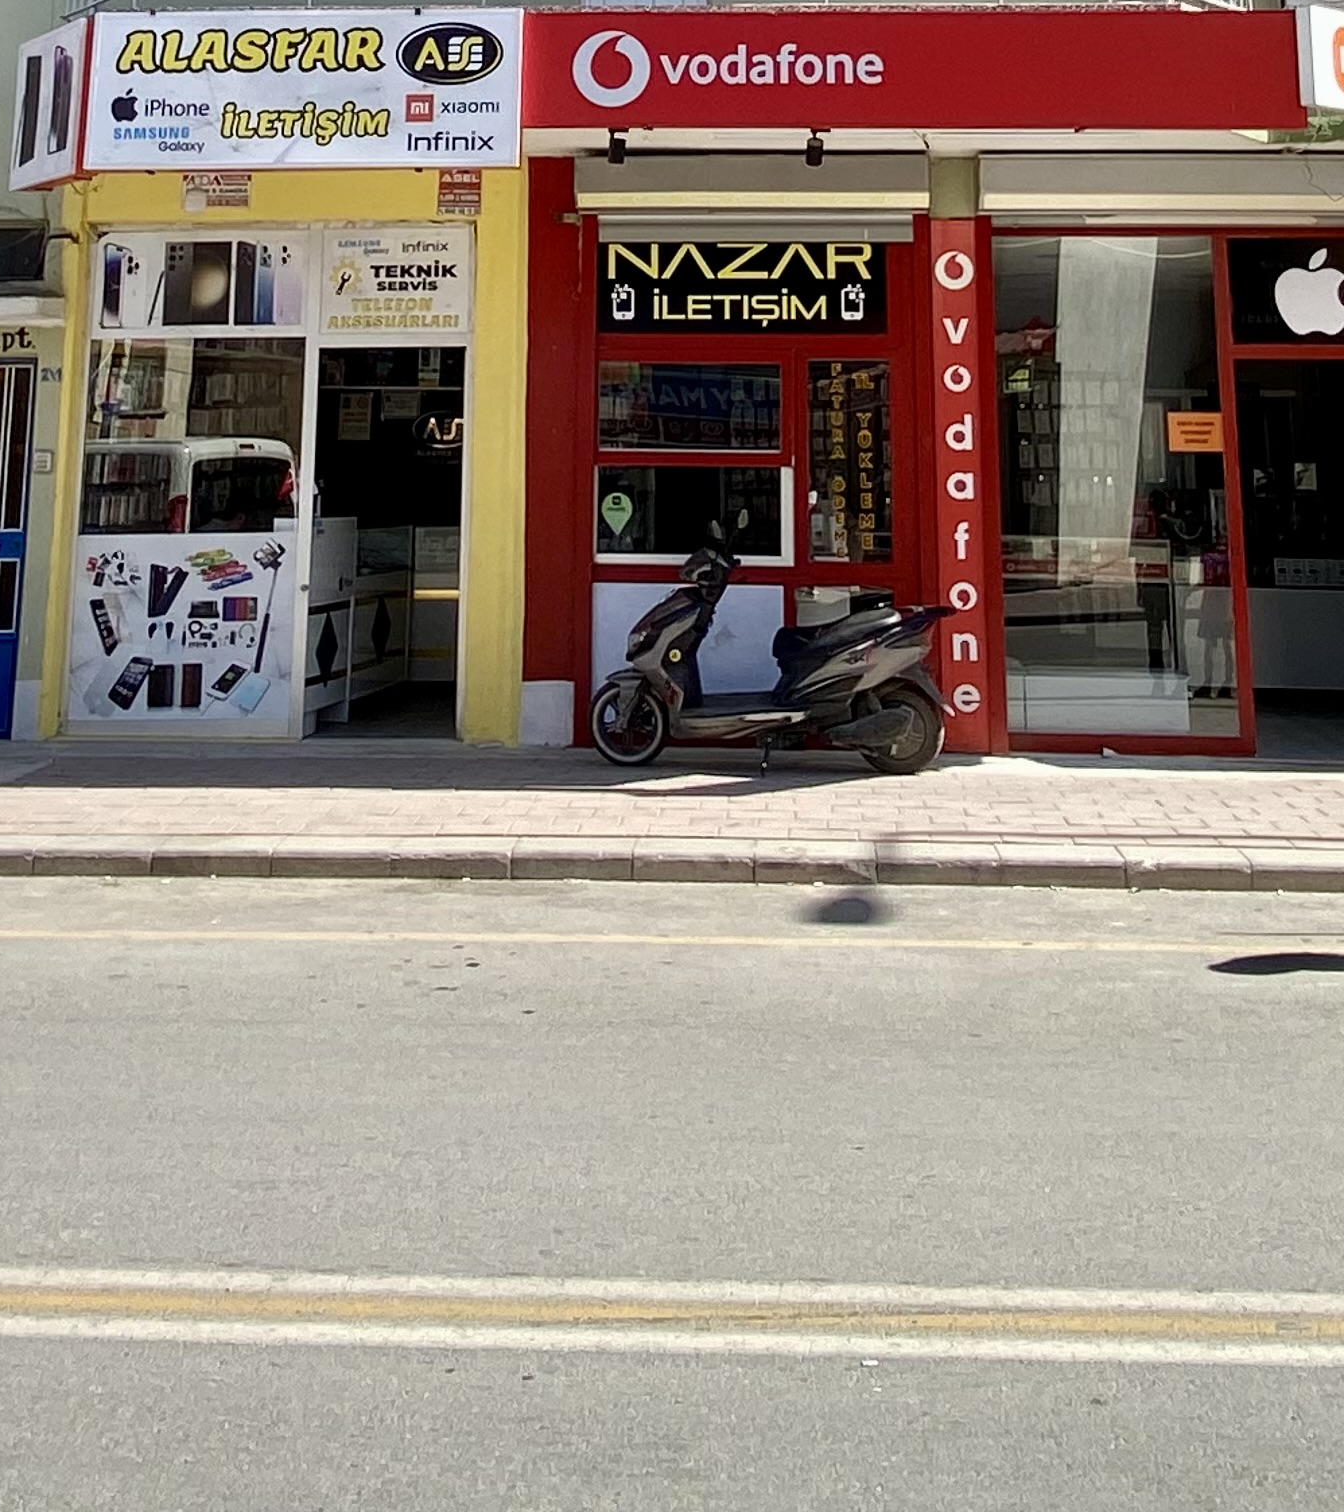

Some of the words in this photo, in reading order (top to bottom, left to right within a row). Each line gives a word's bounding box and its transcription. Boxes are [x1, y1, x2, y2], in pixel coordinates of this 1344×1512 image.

[116, 28, 386, 74] ALASFAR
[660, 44, 885, 85] vodafone
[144, 99, 210, 117] iPhone
[220, 100, 390, 146] İLETİŞİM
[113, 126, 190, 140] SAMSUNG
[407, 131, 494, 152] Infinix
[159, 141, 205, 154] Galaxy
[402, 240, 448, 253] Infinix
[370, 260, 457, 278] TEKNİK
[608, 243, 872, 280] NAZAR
[376, 278, 438, 291] SERVİS
[351, 297, 433, 312] TELEFON
[653, 288, 827, 328] İLETİŞİM
[942, 317, 982, 713] vodafone
